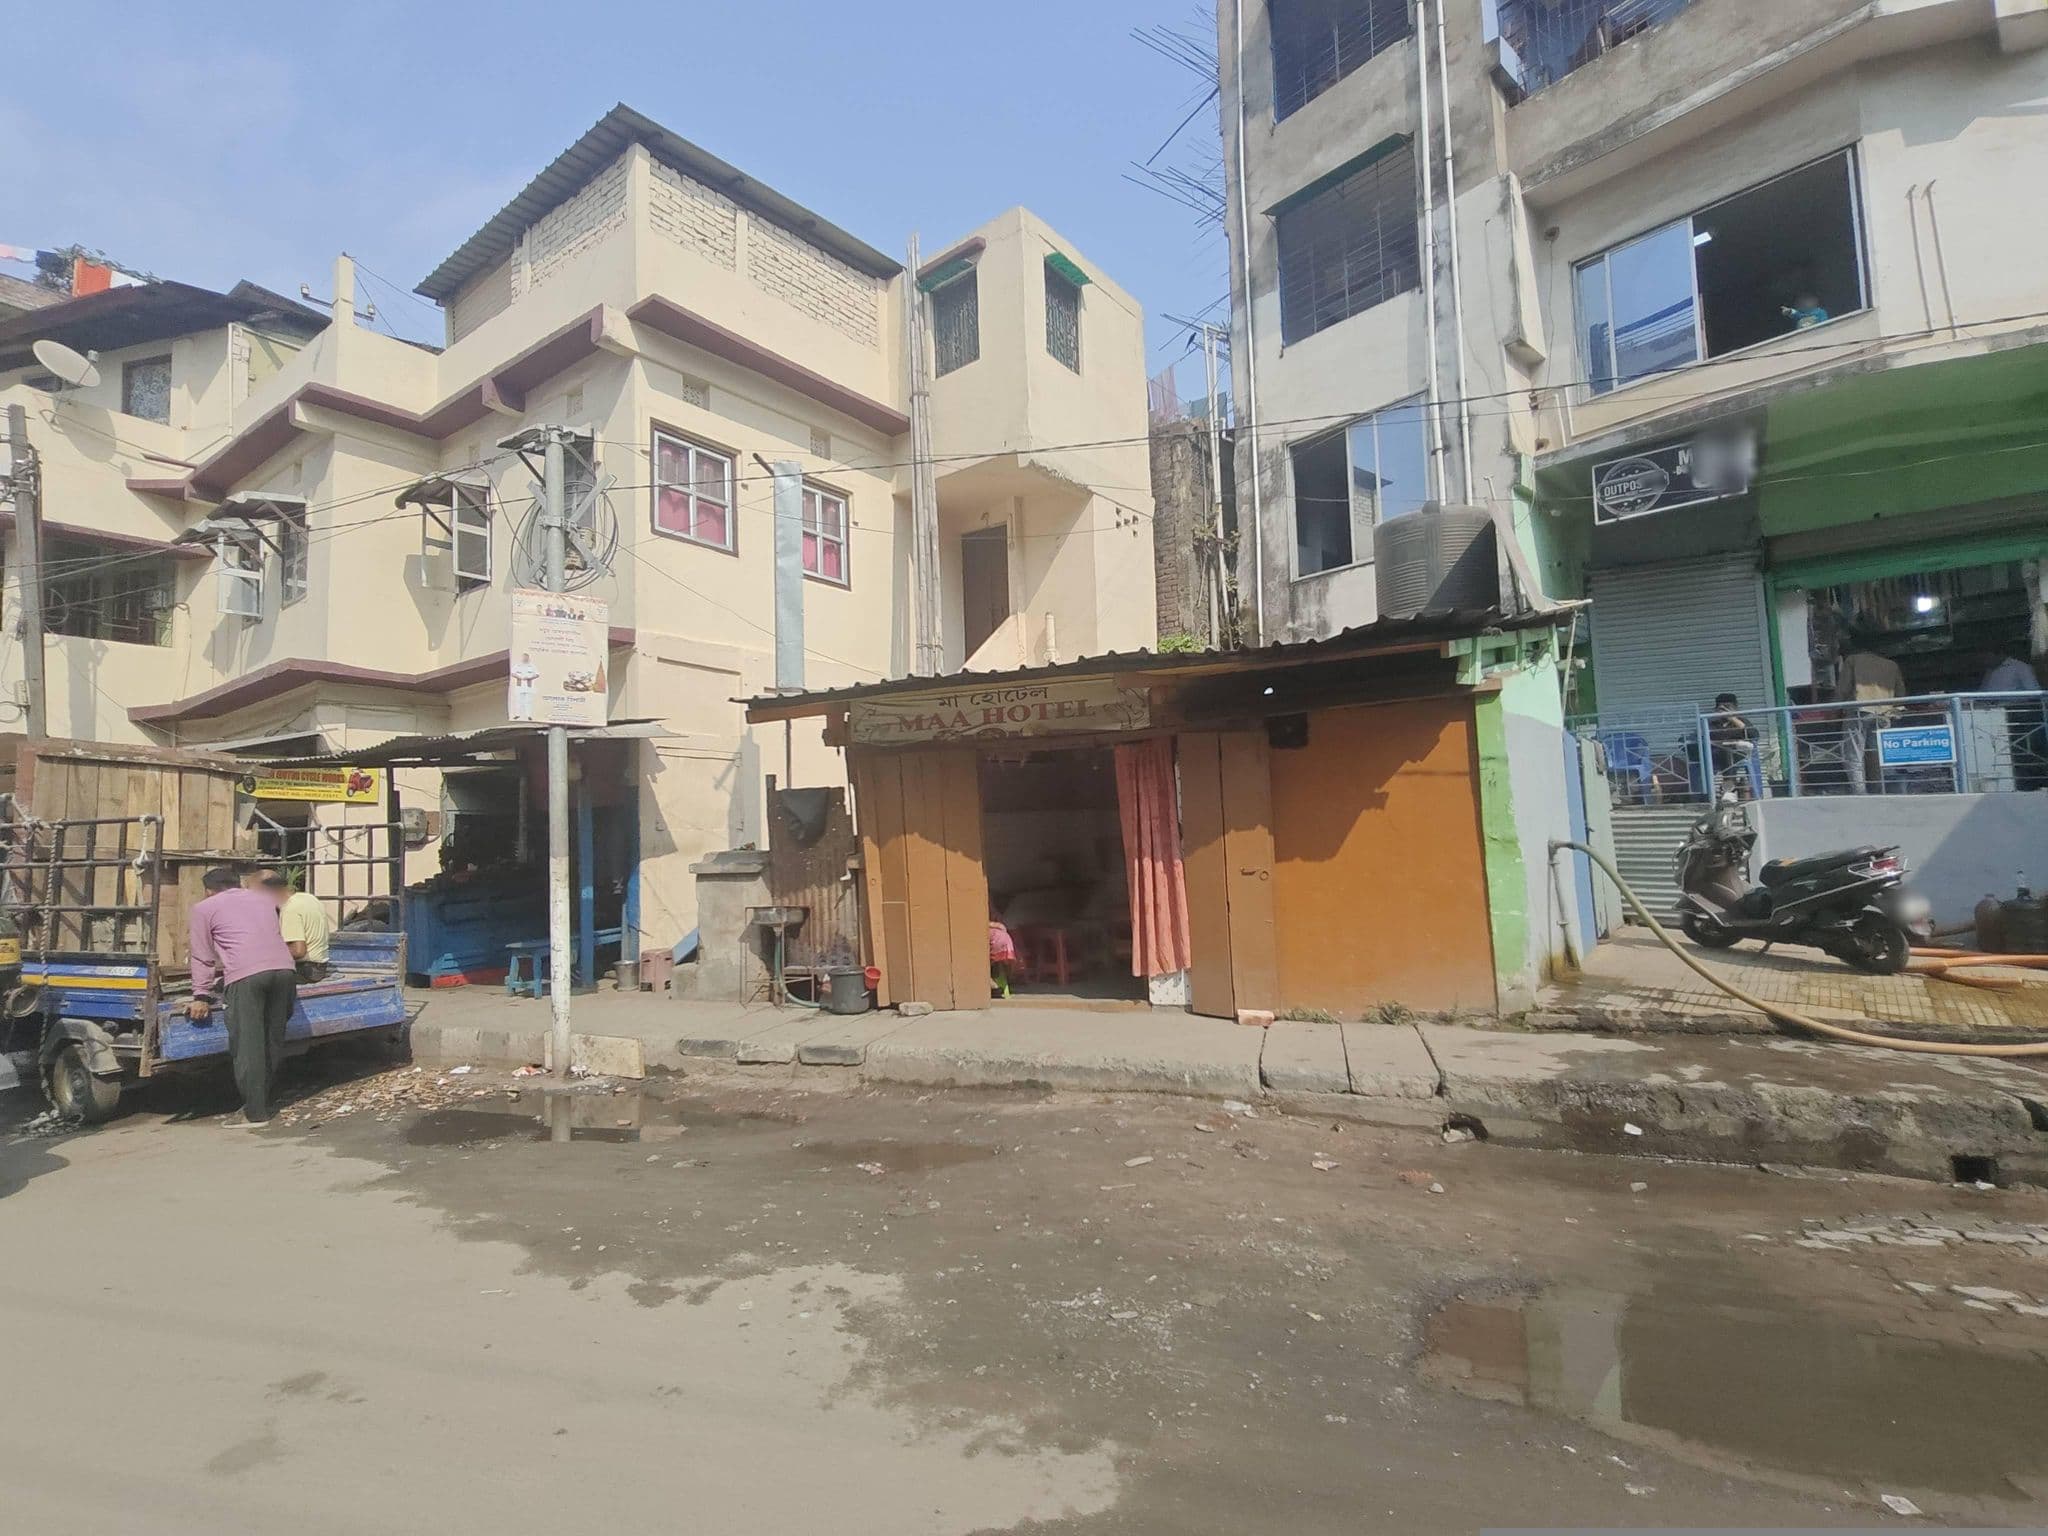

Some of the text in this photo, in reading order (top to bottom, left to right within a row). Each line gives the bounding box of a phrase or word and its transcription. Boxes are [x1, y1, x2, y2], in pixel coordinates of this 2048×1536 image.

[935, 687, 1049, 708] মা হোটেল
[897, 699, 1096, 732] MAA HOTEL
[1883, 737, 1949, 749] No Parking
